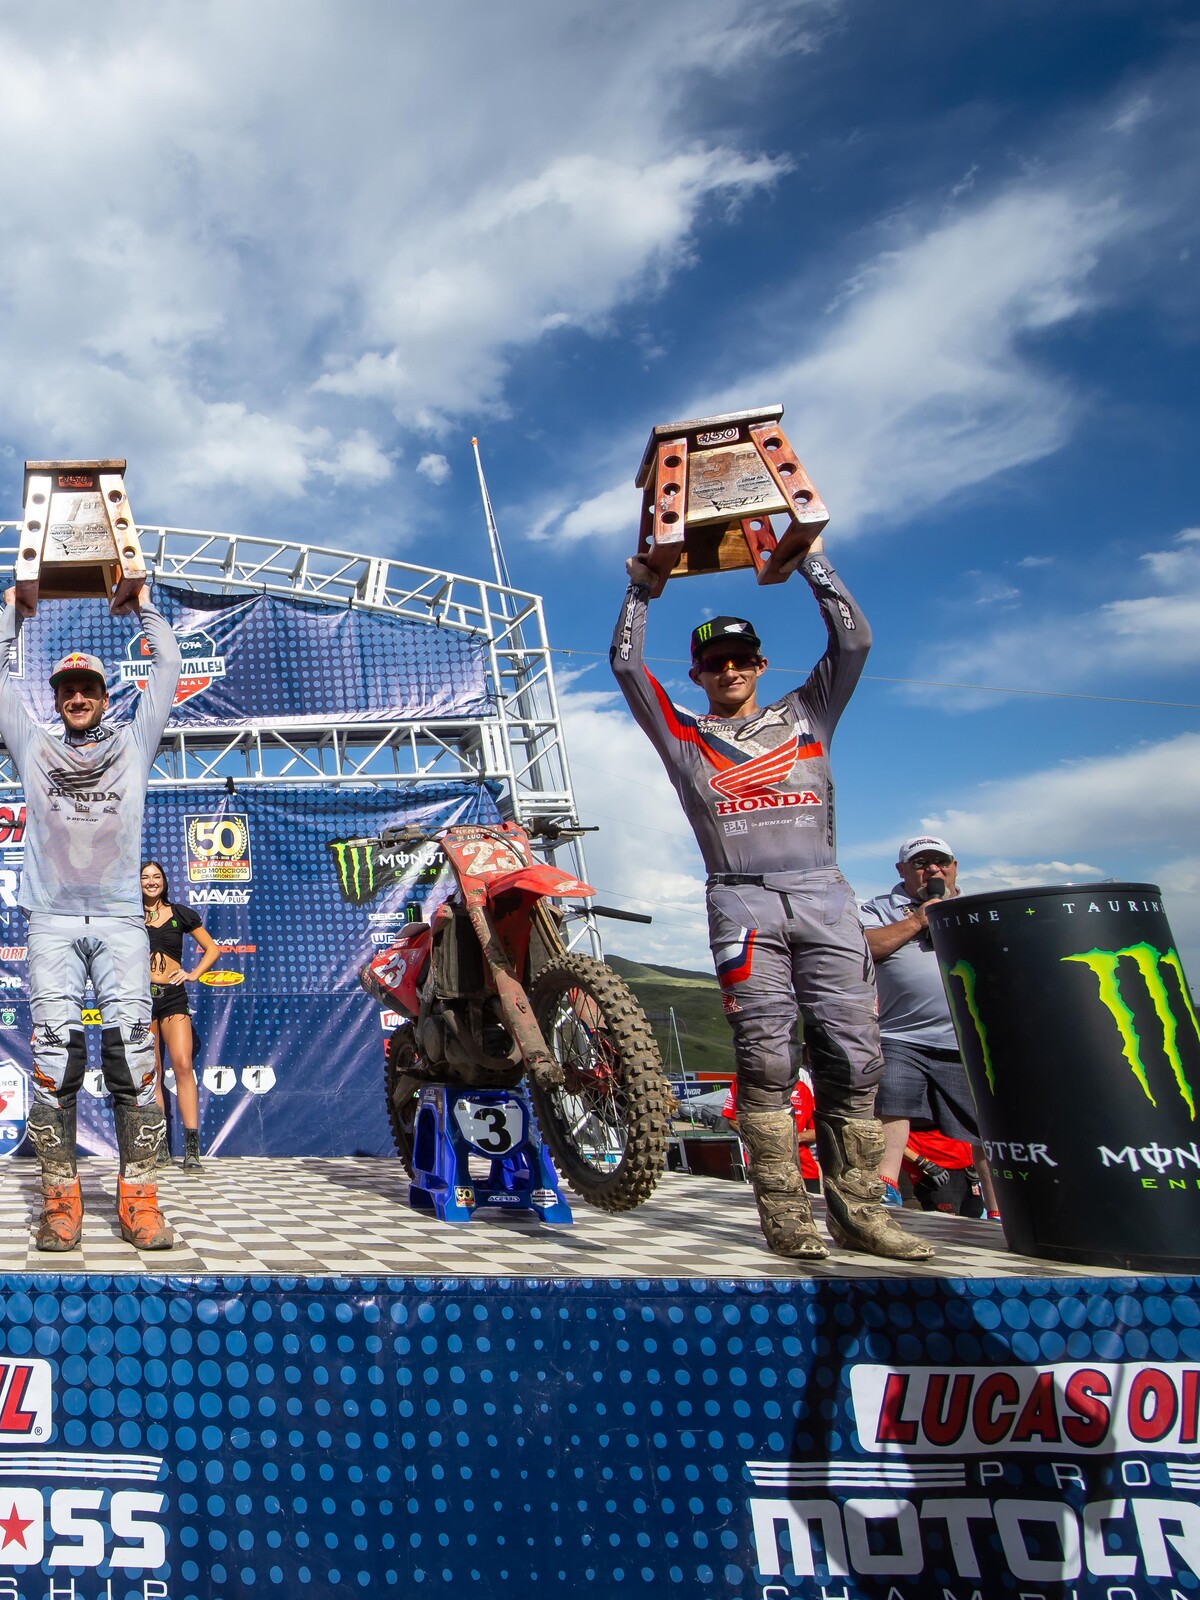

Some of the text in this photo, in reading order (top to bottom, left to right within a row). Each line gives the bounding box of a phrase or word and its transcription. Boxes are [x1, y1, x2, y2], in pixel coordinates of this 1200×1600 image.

[47, 787, 121, 802] HONDA
[716, 790, 822, 816] HONDA
[196, 821, 241, 856] 50
[758, 819, 793, 827] DUNLOP
[462, 839, 529, 875] 23
[368, 912, 405, 920] GEICO
[372, 953, 407, 988] 23
[474, 1107, 511, 1152] 3
[458, 1188, 471, 1198] 50
[875, 1368, 1113, 1449] LUCAS
[979, 1460, 1151, 1491] PRO
